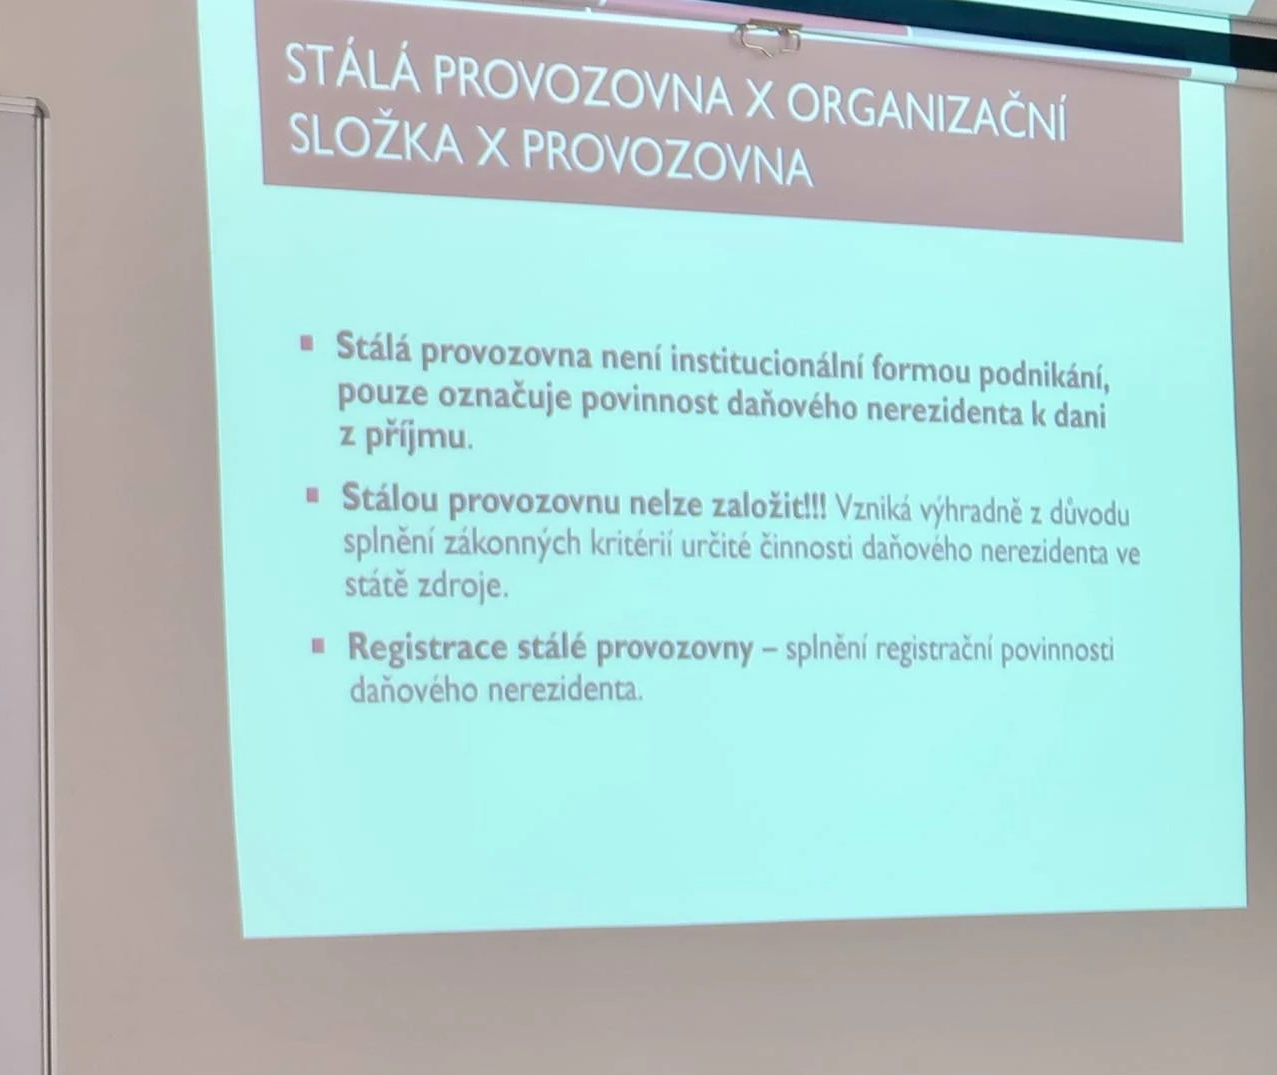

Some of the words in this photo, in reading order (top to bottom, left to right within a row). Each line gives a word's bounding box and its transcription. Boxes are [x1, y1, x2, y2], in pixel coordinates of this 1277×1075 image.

[285, 36, 422, 94] STÁLÁ
[434, 54, 734, 117] PROVOZOVNA
[745, 79, 776, 120] X
[787, 82, 1067, 142] ORGANIZAČNÍ
[289, 107, 464, 165] SLOŽKA
[476, 126, 510, 168] X
[522, 129, 814, 188] PROVOZOVNA
[335, 329, 413, 363] Stálá
[420, 342, 593, 373] provozovna
[601, 343, 663, 372] není
[670, 343, 865, 380] institucionální
[871, 351, 971, 385] formou
[978, 358, 1110, 396] podnikání,
[337, 381, 429, 413] pouze
[438, 379, 572, 418] označuje
[581, 383, 720, 420] povinnost
[726, 387, 859, 421] daňového
[866, 395, 1025, 427] nerezidenta
[1031, 399, 1047, 428] k
[1053, 400, 1107, 430] dani
[338, 425, 357, 447] z
[365, 417, 474, 457] příjmu.
[341, 480, 439, 513] Stálou
[448, 492, 621, 522] provozovnu
[629, 487, 704, 518] nelze
[711, 489, 827, 521] založit!!!
[834, 492, 912, 522] Vzniká
[919, 494, 1023, 530] výhradně
[1030, 506, 1044, 526] z
[1050, 496, 1130, 528] důvodu
[343, 524, 436, 564] splnění
[443, 525, 581, 565] zákonných
[590, 527, 673, 558] kritérií
[681, 530, 752, 560] určité
[759, 531, 853, 561] činnosti
[861, 532, 973, 563] daňového
[980, 536, 1109, 566] nerezidenta
[1115, 546, 1141, 566] ve
[344, 567, 409, 598] státě
[417, 568, 509, 606] zdroje.
[347, 630, 508, 670] Registrace
[516, 630, 587, 661] stálé
[596, 638, 755, 669] provozovny
[785, 632, 868, 669] splnění
[876, 633, 993, 669] registrační
[1000, 635, 1115, 670] povinnosti
[349, 673, 479, 705] daňového
[488, 672, 643, 703] nerezidenta.
